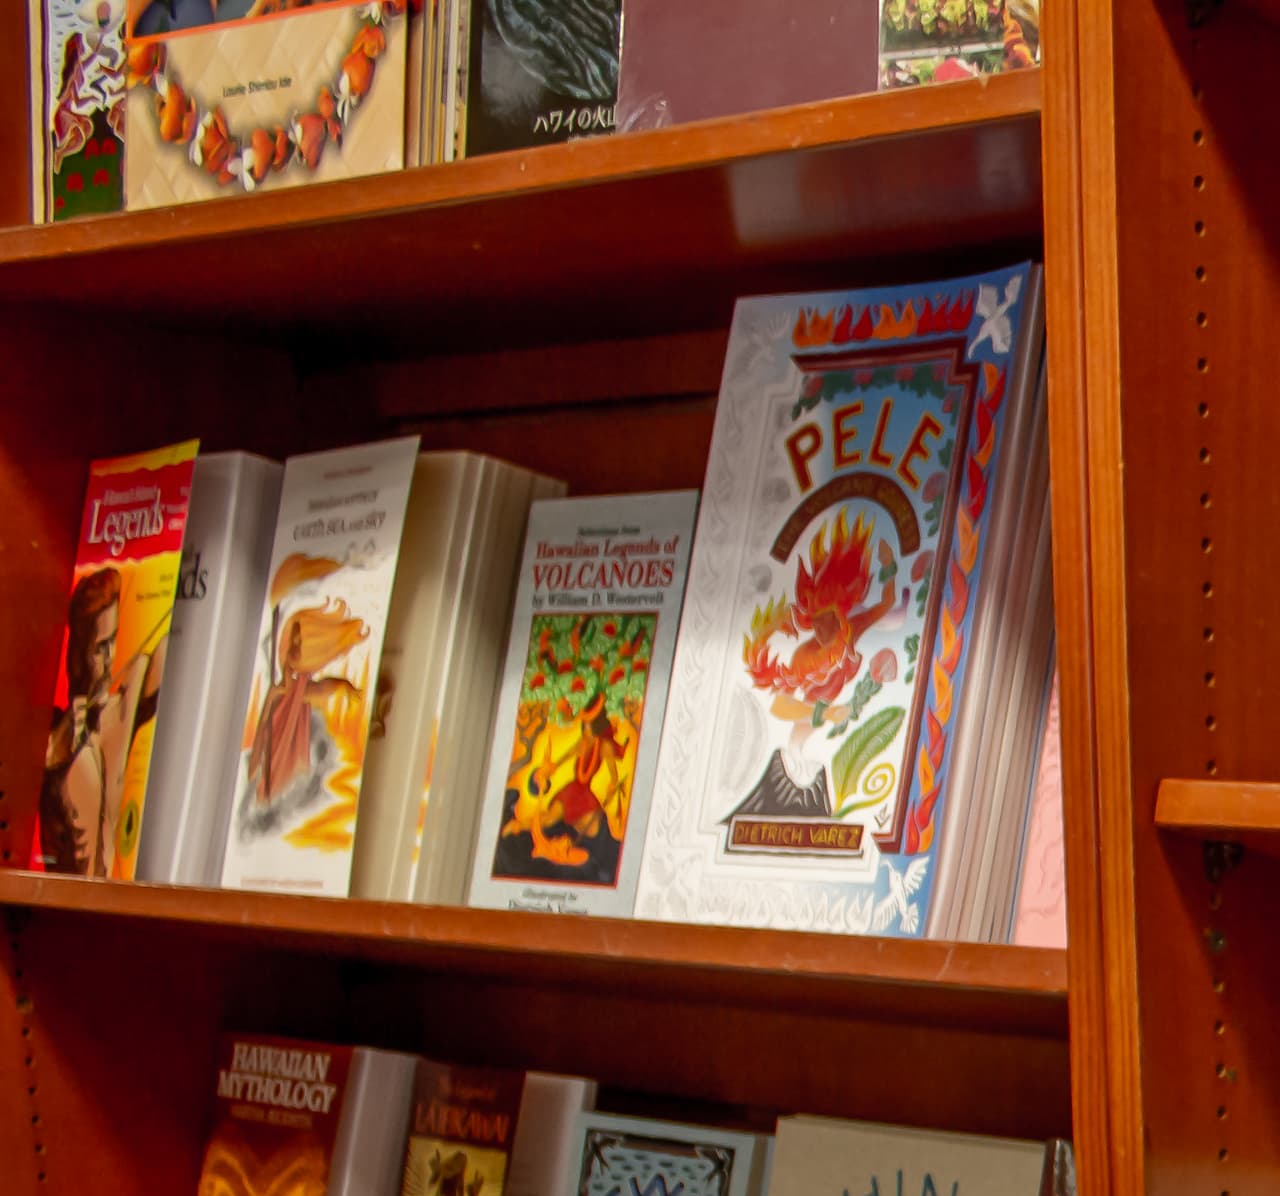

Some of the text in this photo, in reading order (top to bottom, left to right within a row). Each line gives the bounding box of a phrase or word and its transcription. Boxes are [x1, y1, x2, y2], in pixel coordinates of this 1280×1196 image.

[784, 396, 944, 495] PELE
[88, 488, 163, 557] Legends
[536, 534, 679, 562] Hawaiian Legends of
[532, 558, 675, 592] VOLCANOES
[735, 823, 858, 849] DIETRICH VAREZ
[231, 1042, 332, 1082] HAWAIIAN
[217, 1070, 337, 1114] MYTHOLOGY
